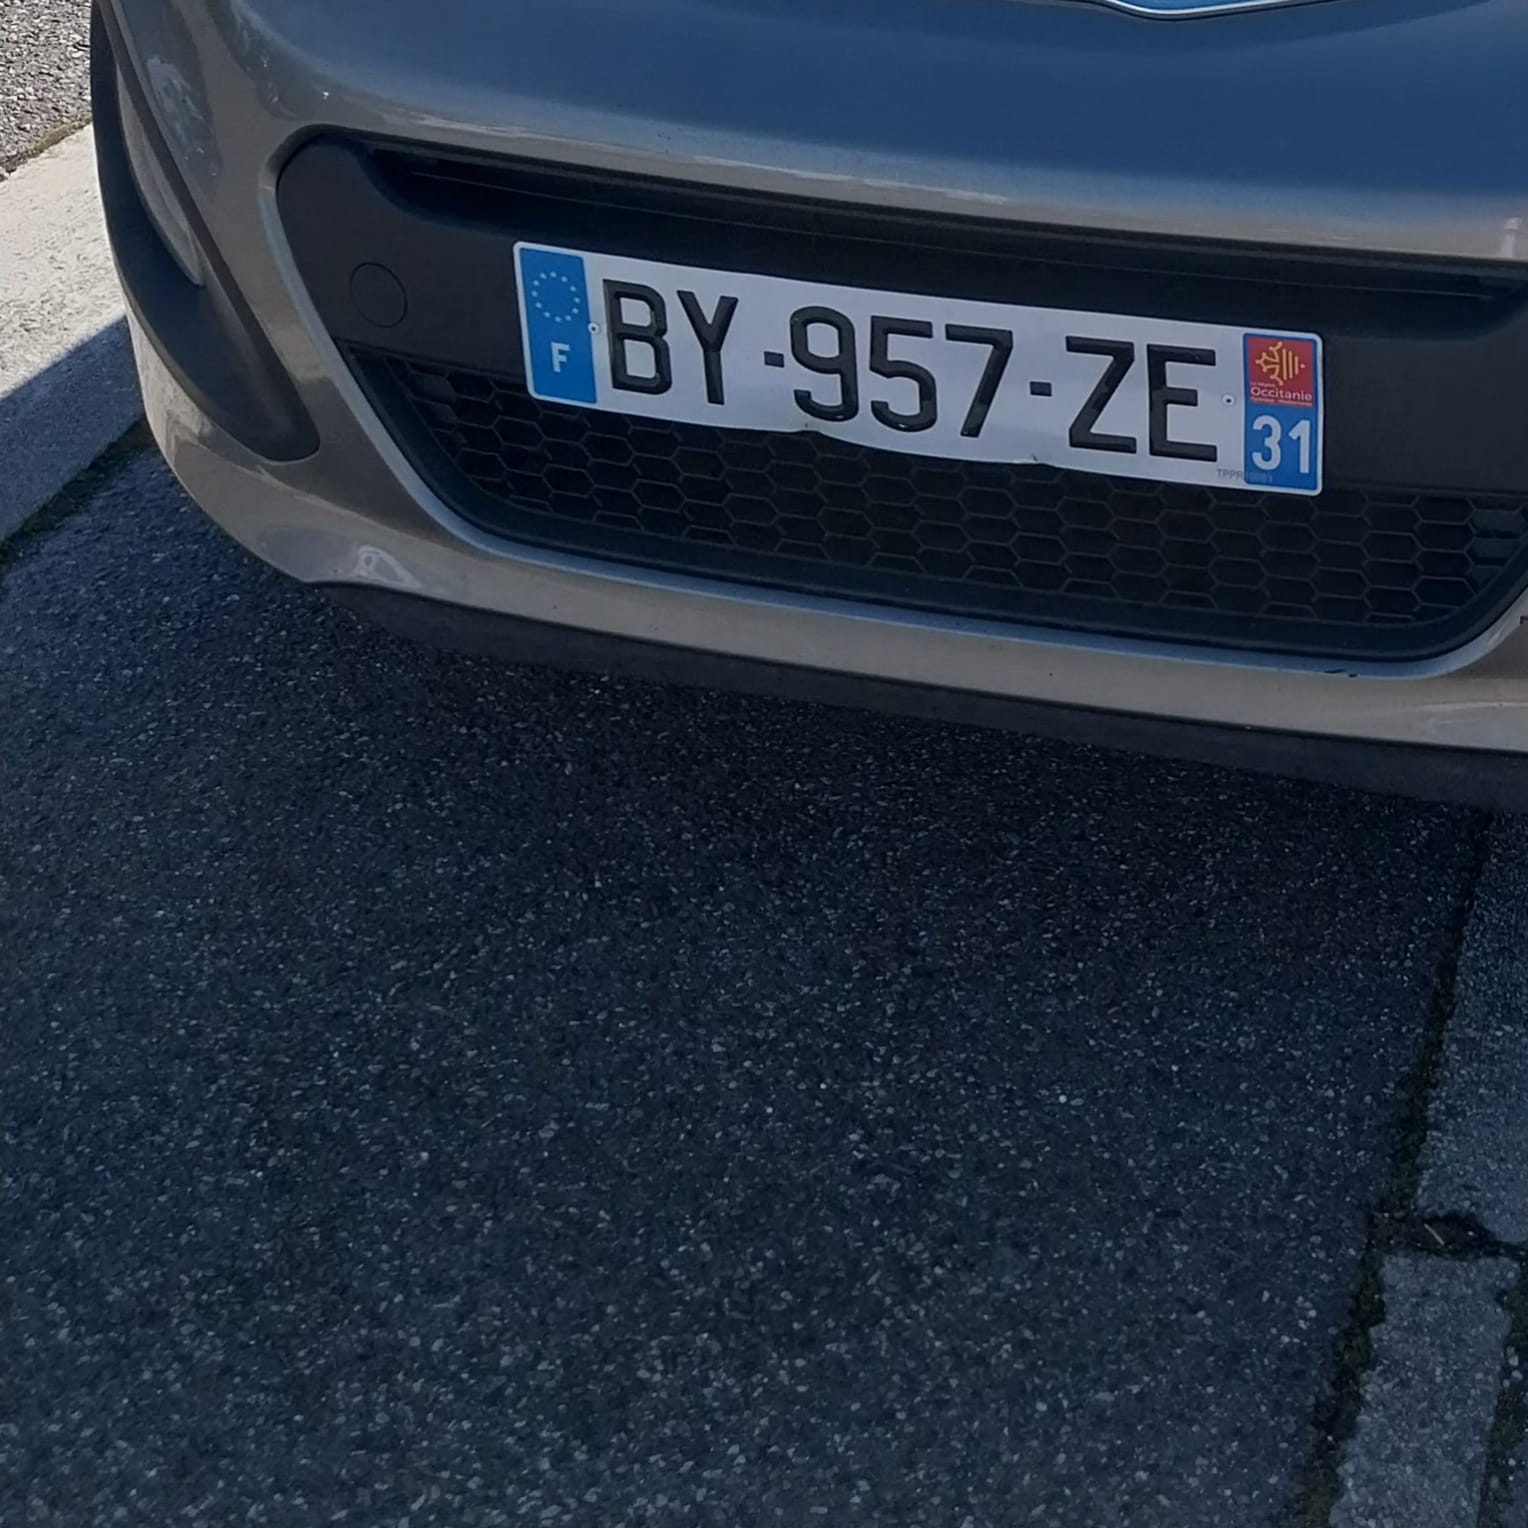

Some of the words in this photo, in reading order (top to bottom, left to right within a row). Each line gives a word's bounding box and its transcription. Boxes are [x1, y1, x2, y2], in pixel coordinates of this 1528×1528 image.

[551, 342, 570, 373] F
[603, 279, 1218, 462] BY-957-ZE
[1250, 385, 1313, 402] Occitanie
[1252, 415, 1311, 474] 31
